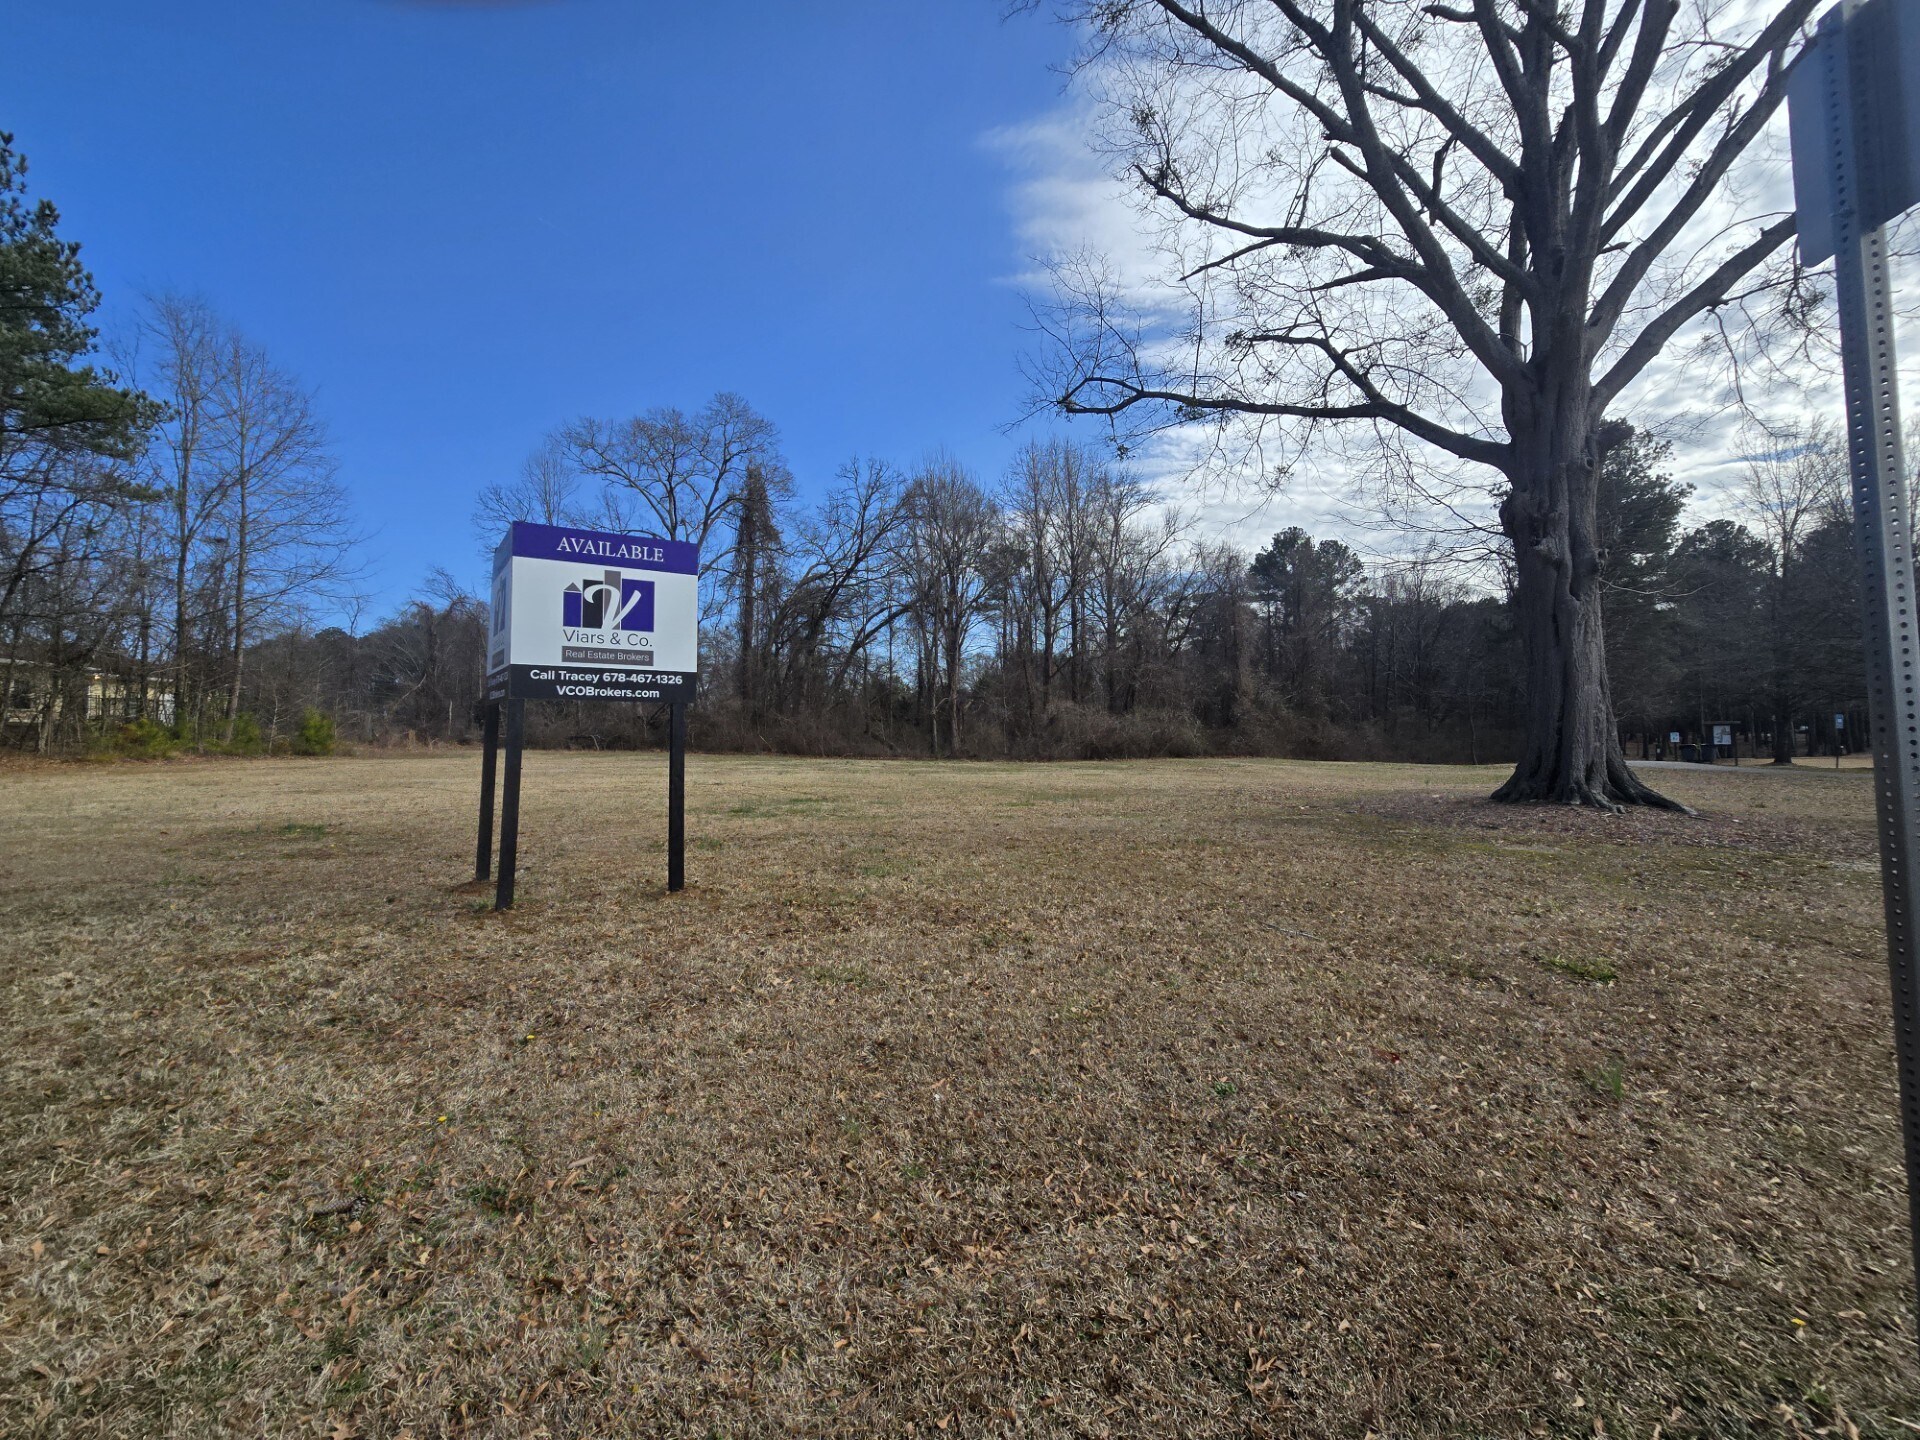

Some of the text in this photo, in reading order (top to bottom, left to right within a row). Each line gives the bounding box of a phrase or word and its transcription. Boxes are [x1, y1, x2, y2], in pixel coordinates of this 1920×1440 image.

[557, 537, 664, 562] AVAILABLE
[562, 629, 653, 647] Viars & Co.
[565, 650, 650, 662] Real Estate Brokers
[530, 669, 683, 685] Call Tracey 678-467-1326
[556, 685, 660, 698] VCOBrokers.com
